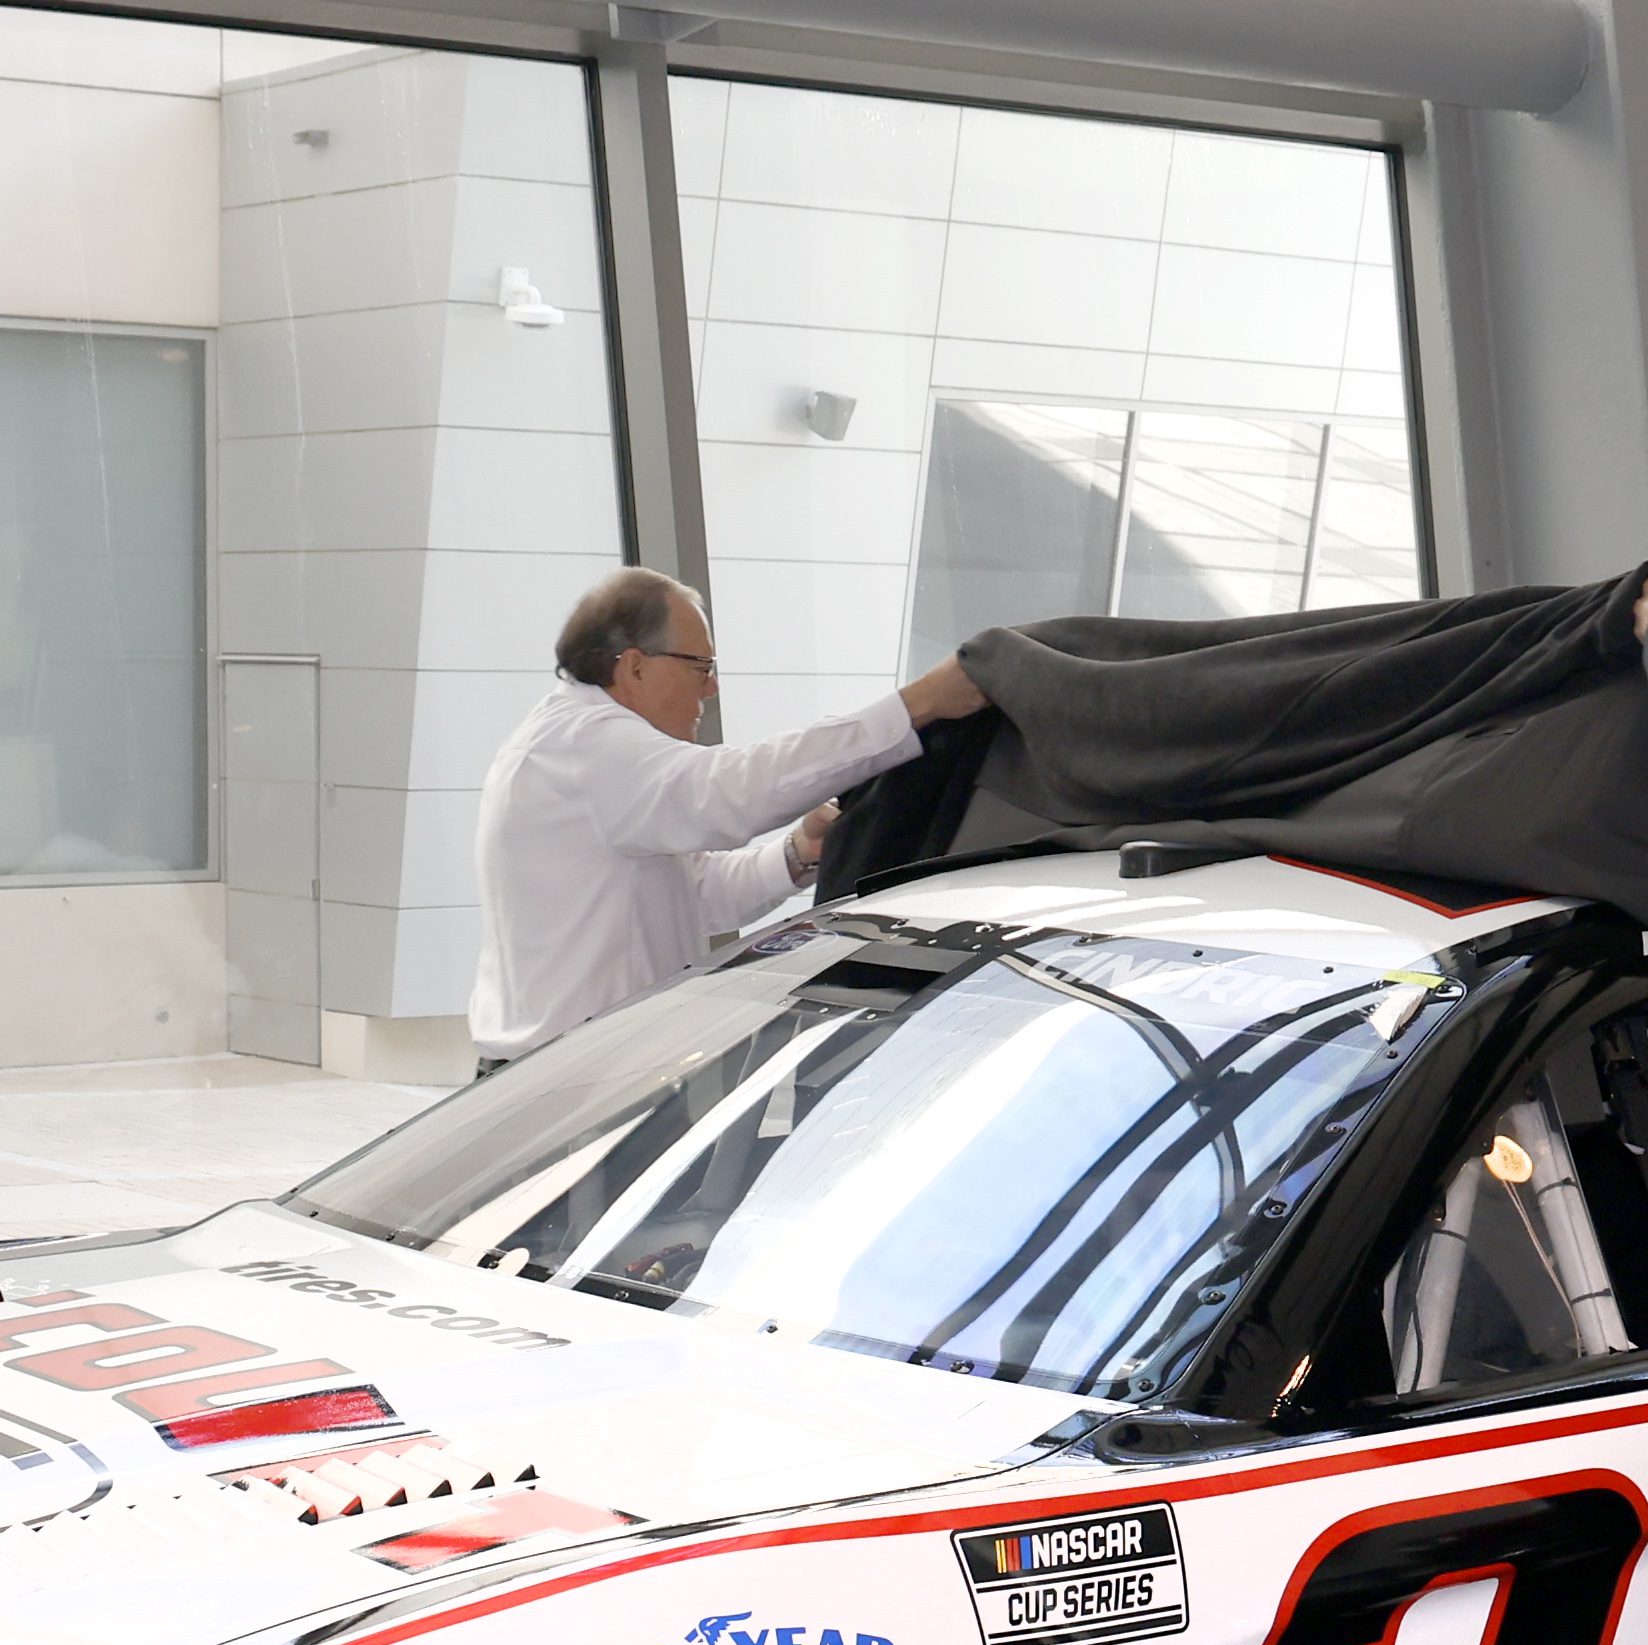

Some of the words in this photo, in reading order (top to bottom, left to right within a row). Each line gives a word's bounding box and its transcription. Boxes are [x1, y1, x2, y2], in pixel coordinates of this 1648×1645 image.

[218, 1260, 573, 1352] tires.com
[1031, 1519, 1143, 1570] NASCAR
[1007, 1590, 1058, 1627] CUP
[1062, 1573, 1154, 1619] SERIES
